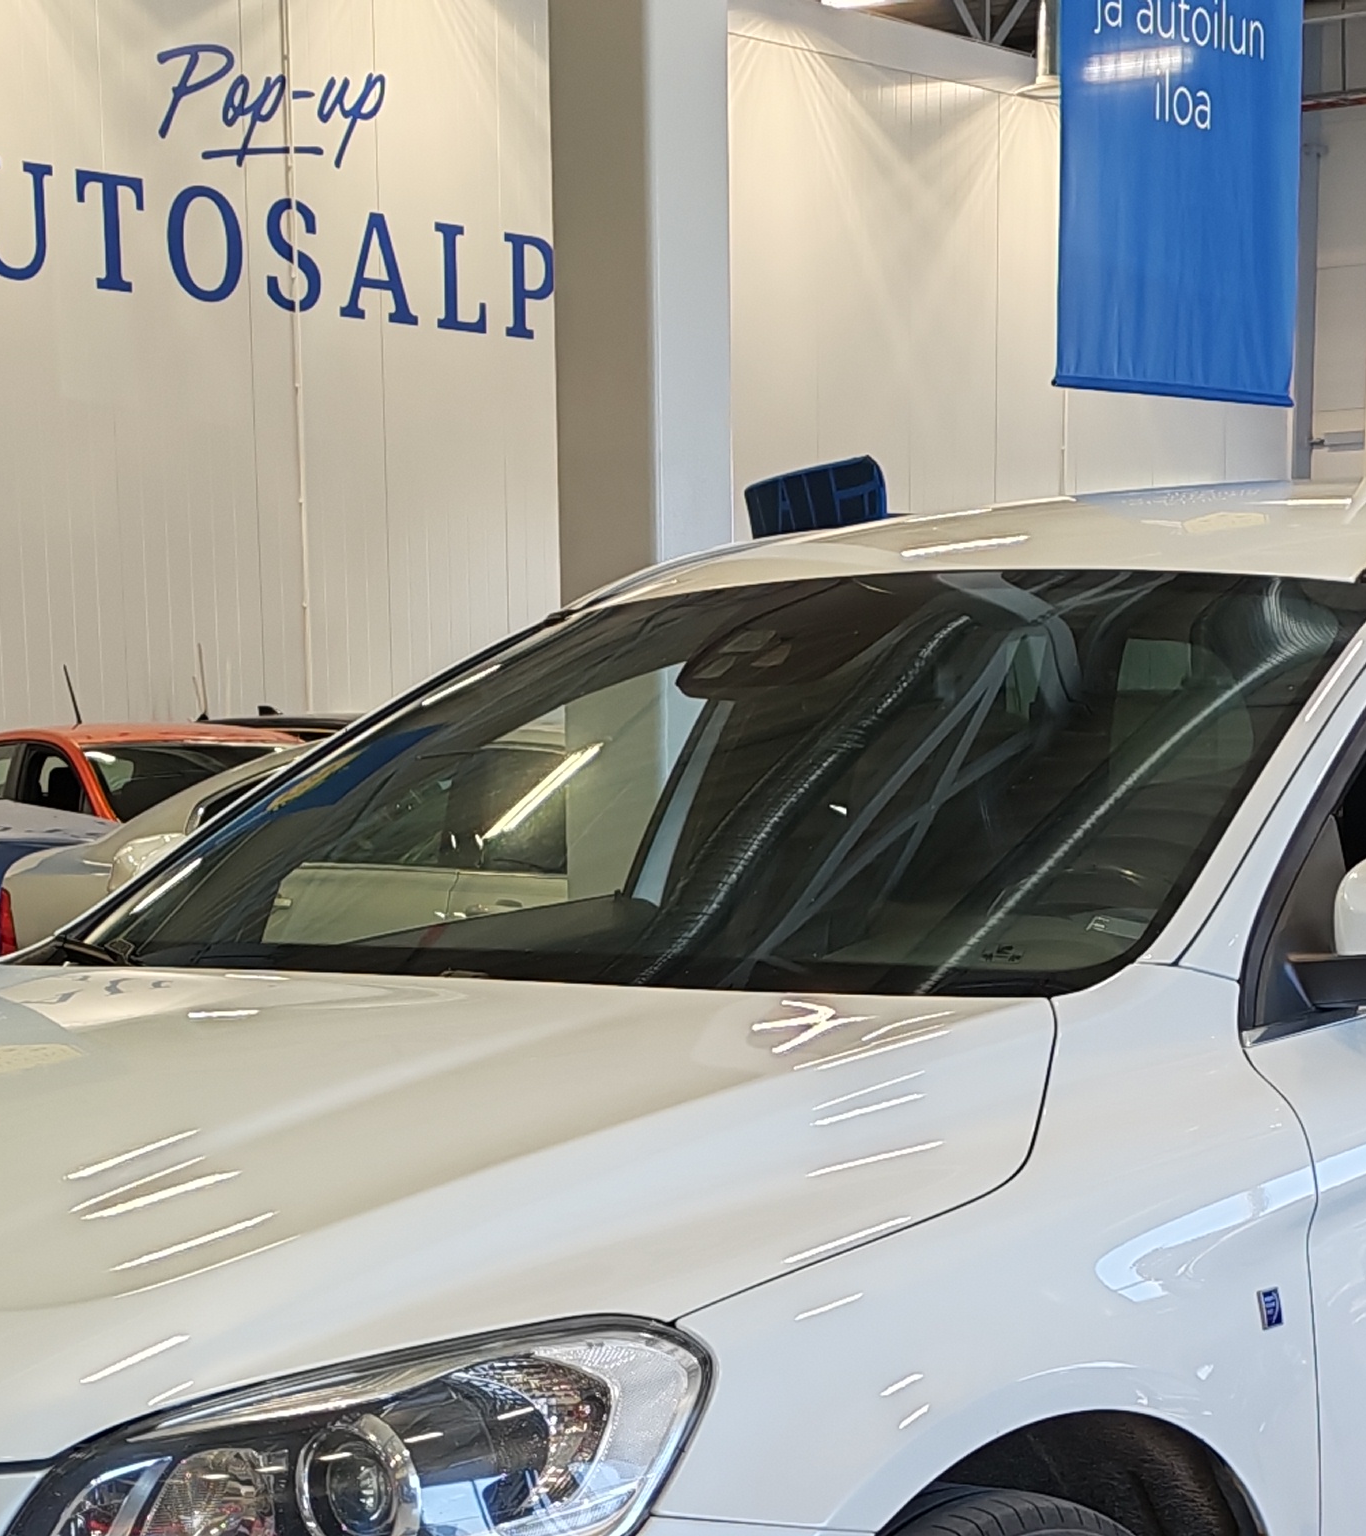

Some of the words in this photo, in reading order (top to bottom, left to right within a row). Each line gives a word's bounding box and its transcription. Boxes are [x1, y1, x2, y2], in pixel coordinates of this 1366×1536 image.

[1093, 0, 1123, 35] ja
[1136, 0, 1265, 61] autoilun
[156, 43, 386, 168] Pop-up
[1154, 67, 1212, 131] iloa
